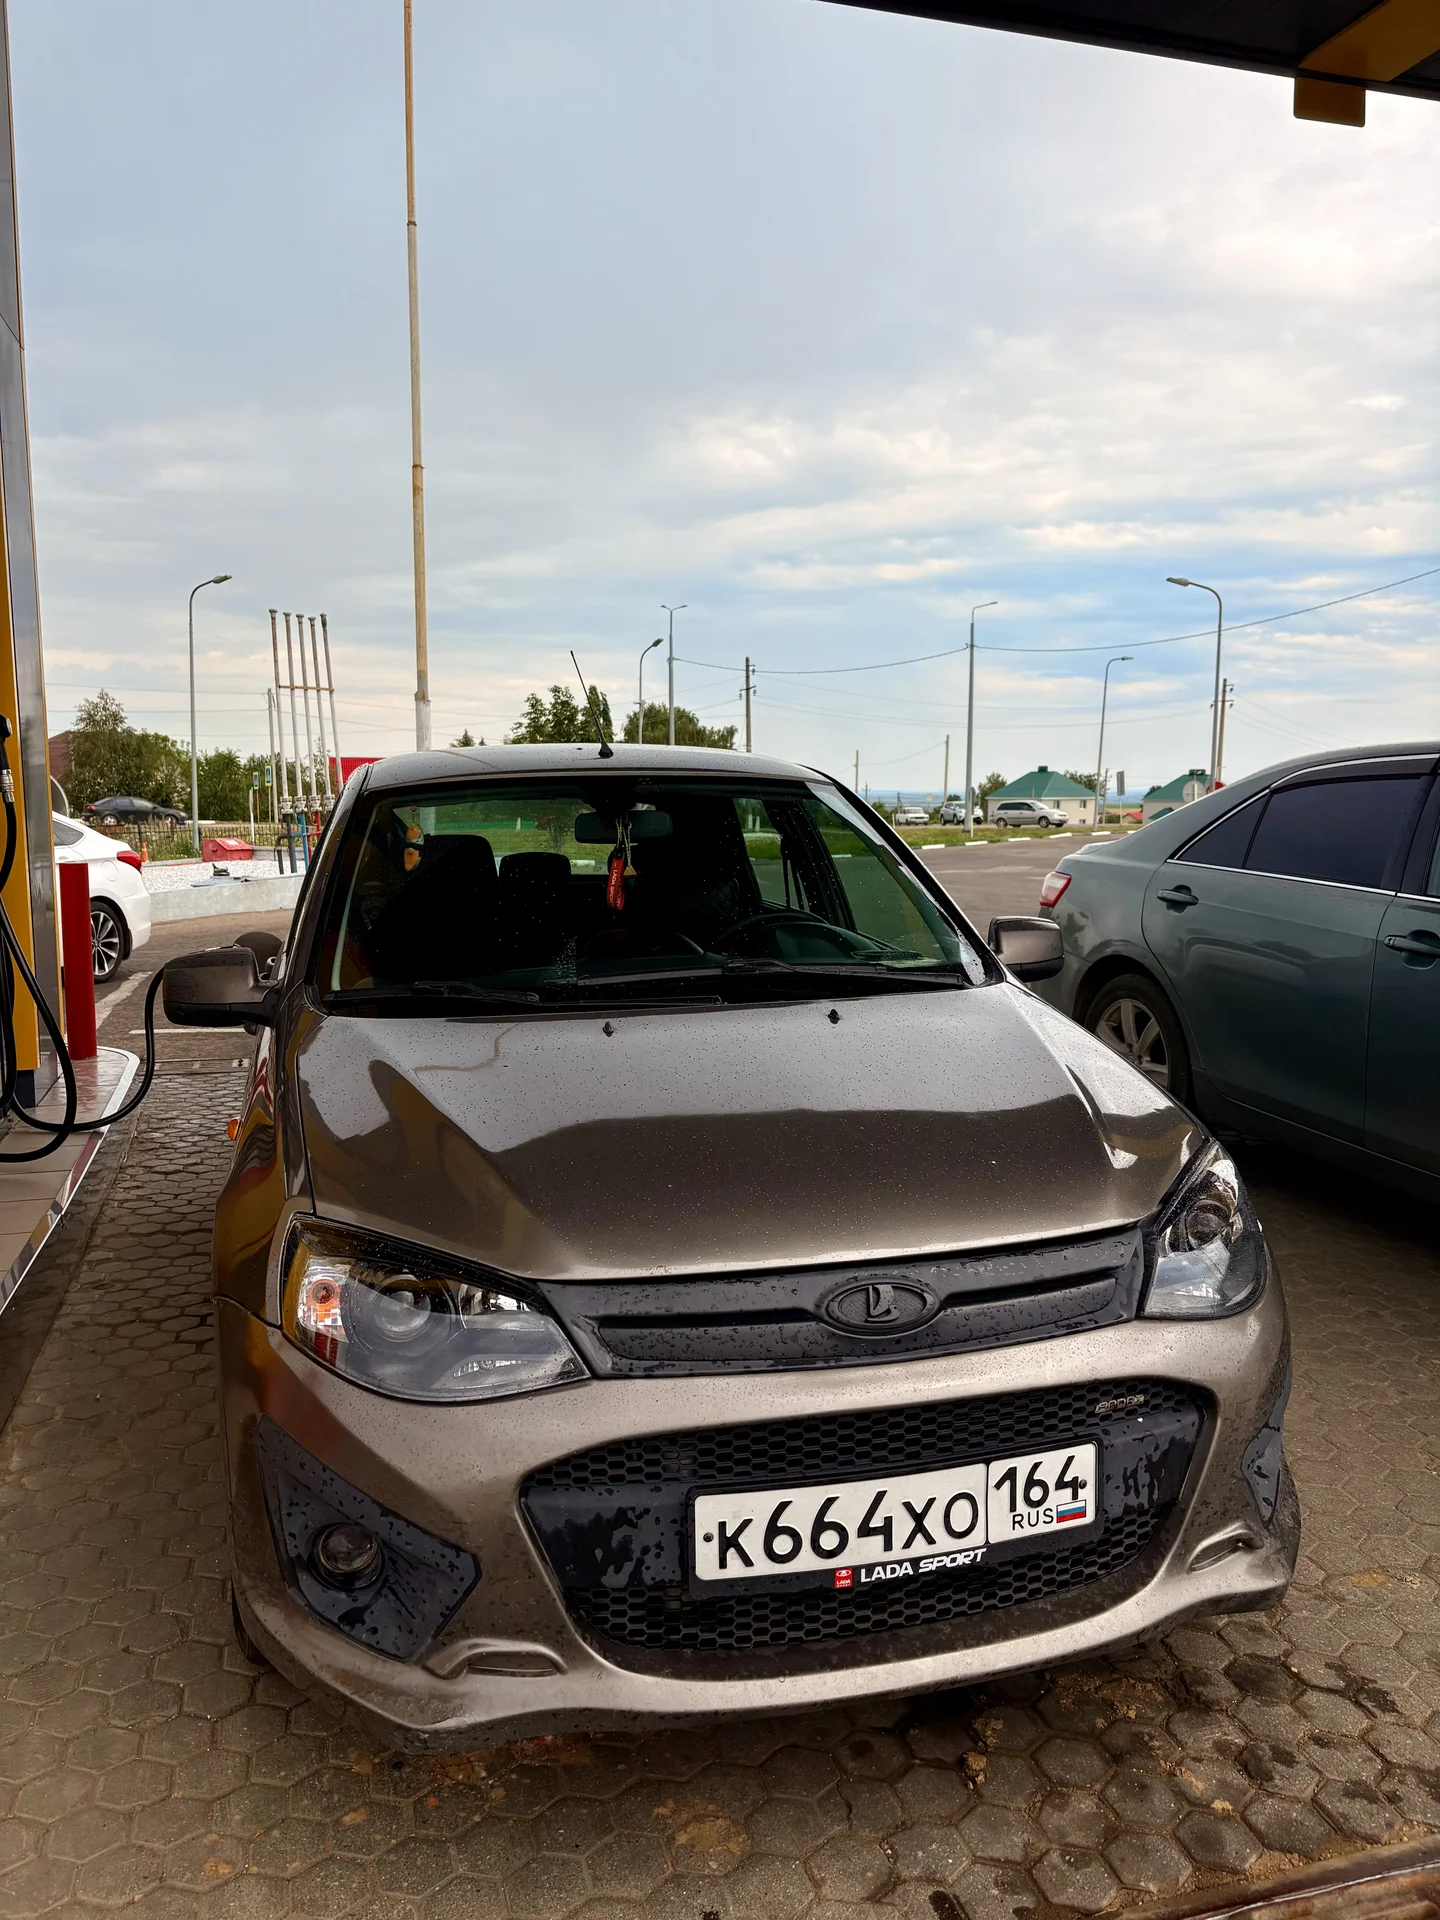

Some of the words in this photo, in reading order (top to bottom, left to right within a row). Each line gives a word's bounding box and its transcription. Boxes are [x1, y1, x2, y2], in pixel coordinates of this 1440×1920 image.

[992, 1455, 1080, 1513] 164
[1012, 1507, 1054, 1531] RUS
[860, 1562, 914, 1583] LADA
[918, 1548, 987, 1573] SPORT
